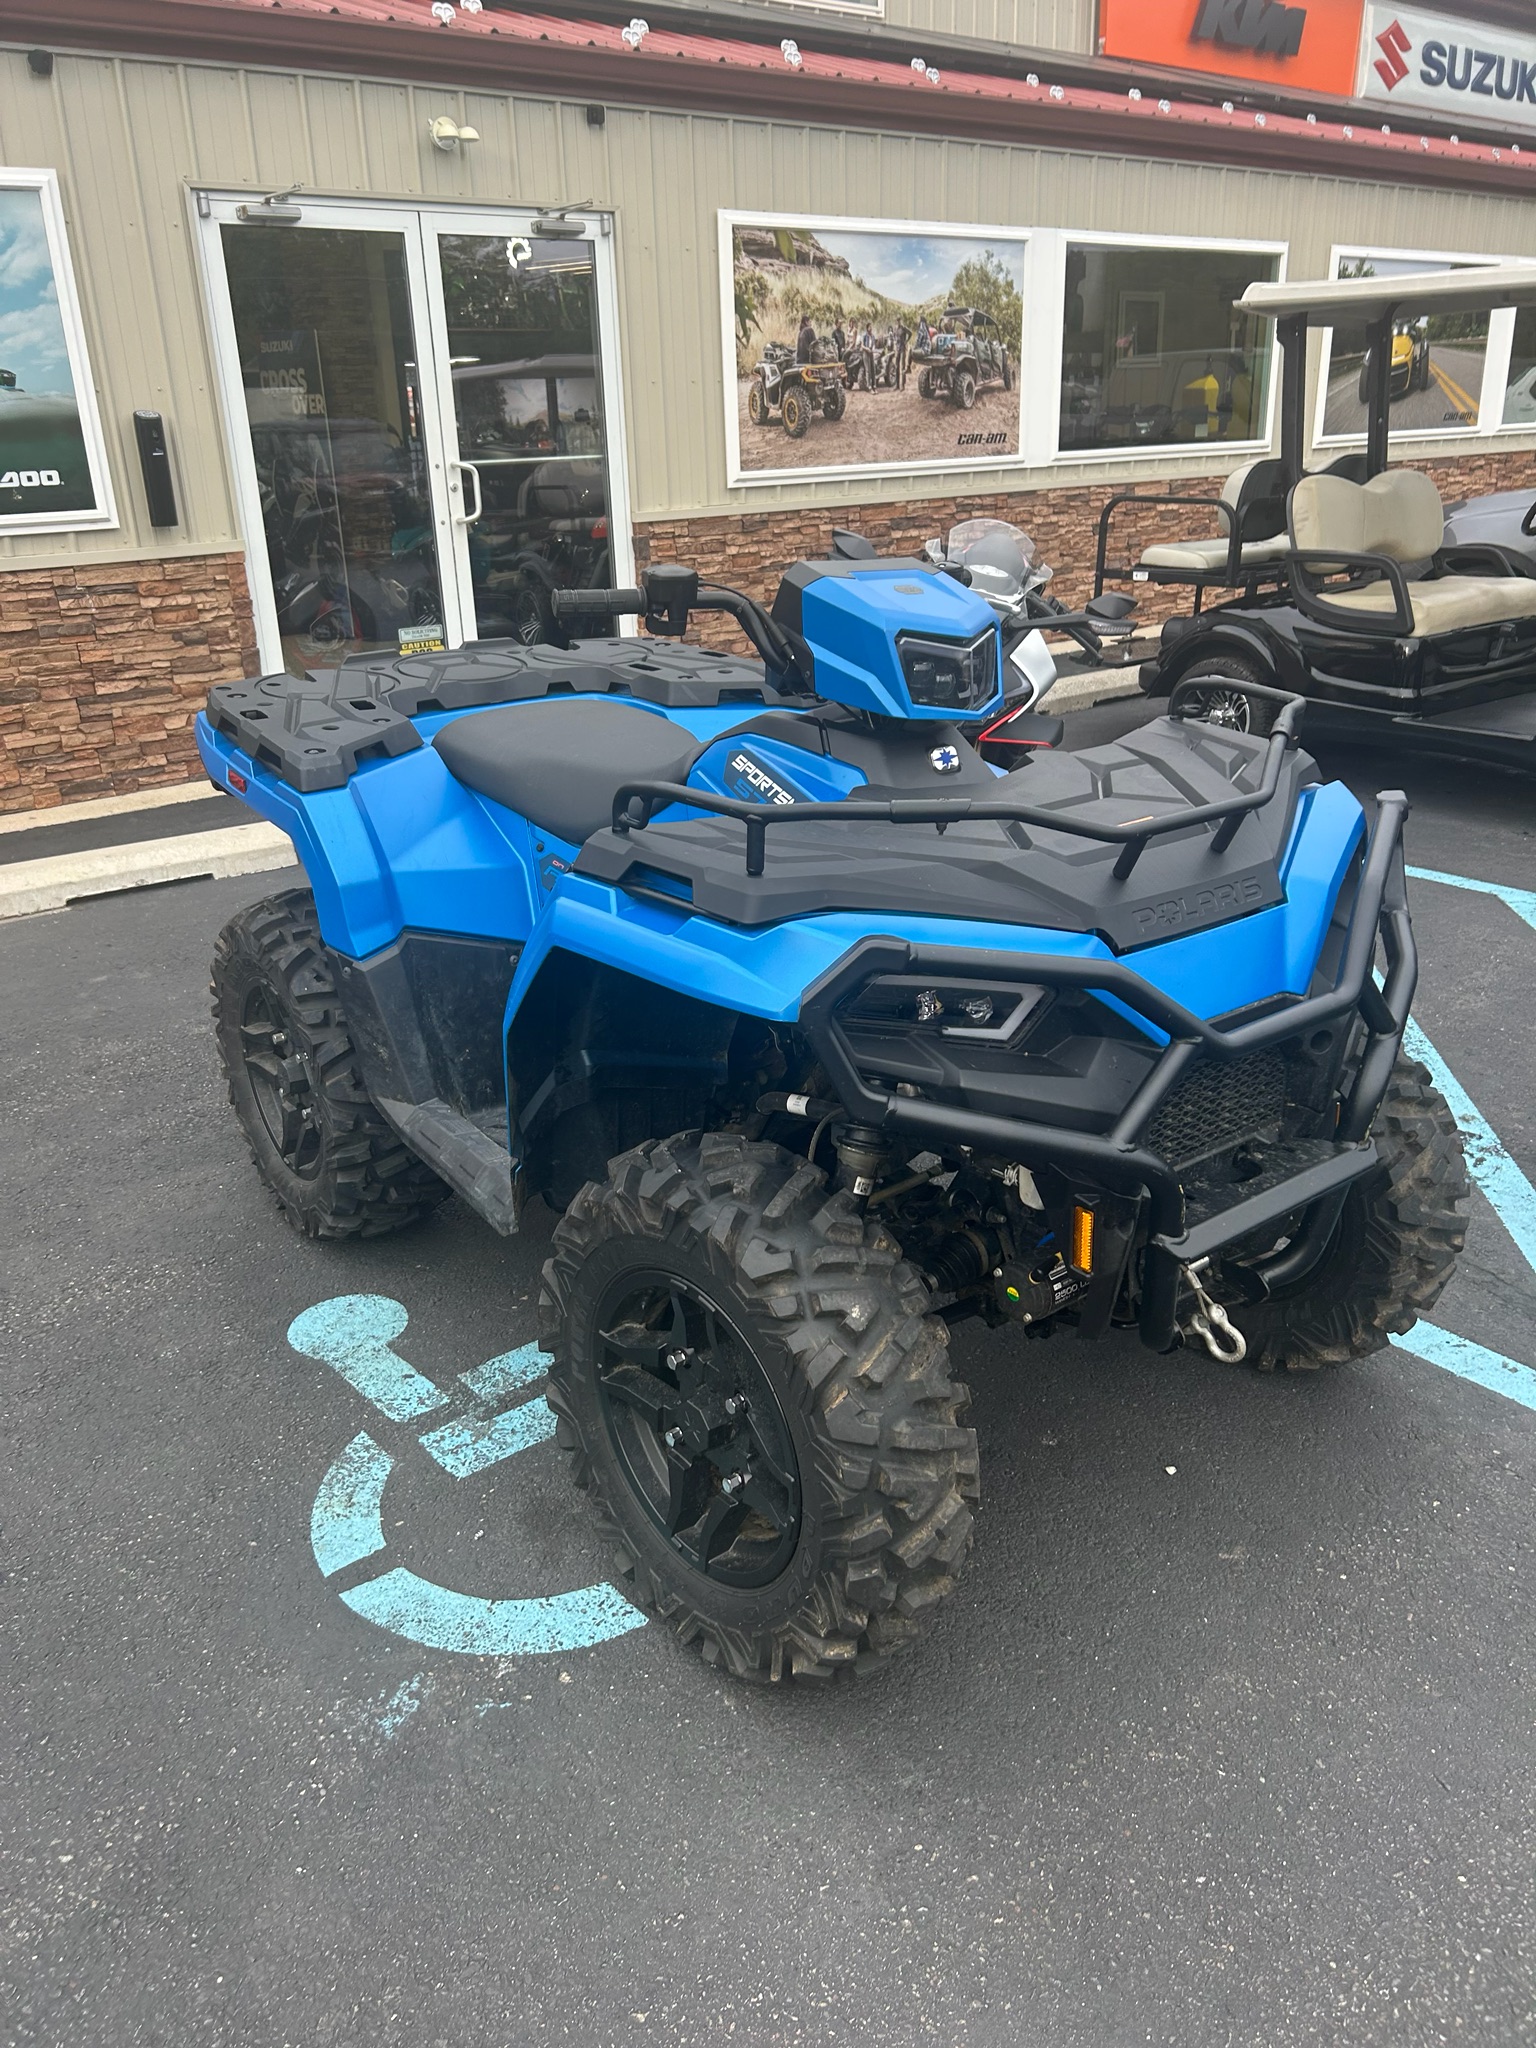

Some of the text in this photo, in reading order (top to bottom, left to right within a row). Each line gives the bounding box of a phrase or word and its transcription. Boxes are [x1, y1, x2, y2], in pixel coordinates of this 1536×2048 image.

[1191, 0, 1306, 57] KTM
[260, 340, 294, 353] SUZUKI
[260, 367, 307, 395] CROSS
[292, 393, 325, 415] OVER
[401, 640, 441, 650] CAUTION
[731, 754, 795, 805] SPORTS
[1131, 875, 1264, 936] POLARIS
[1054, 1283, 1078, 1301] 2500
